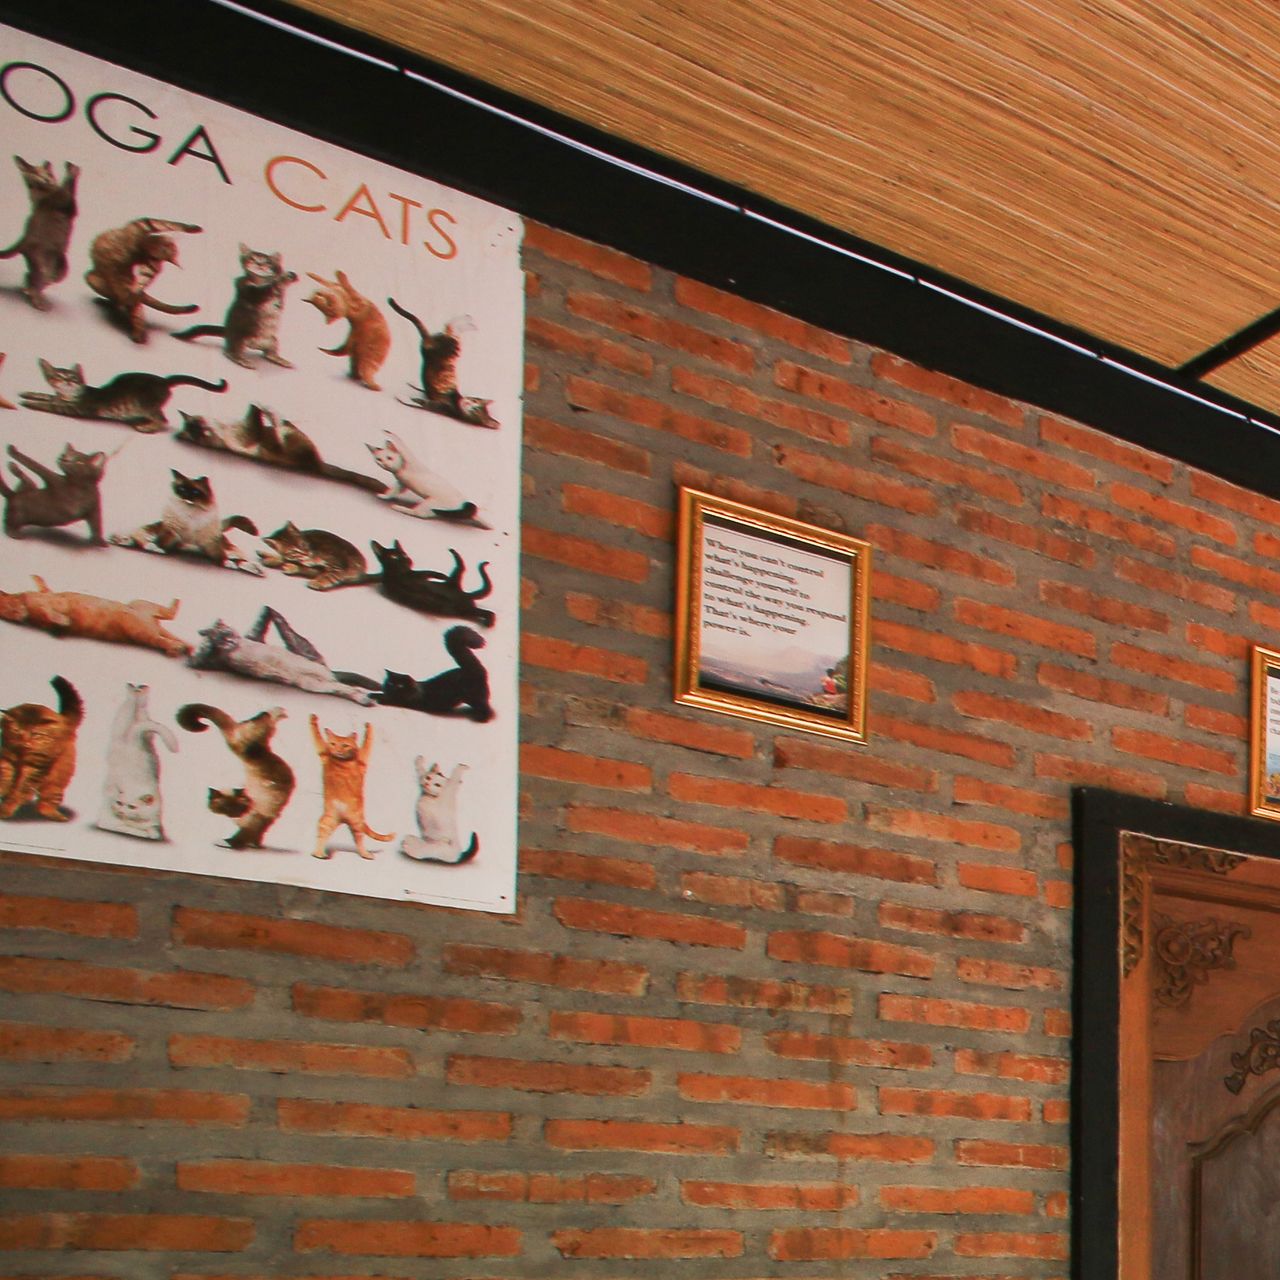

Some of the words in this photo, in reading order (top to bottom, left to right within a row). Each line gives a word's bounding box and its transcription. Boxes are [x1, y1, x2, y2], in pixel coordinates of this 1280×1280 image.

[264, 155, 458, 261] CATS
[705, 537, 737, 553] When
[740, 550, 758, 560] you
[787, 563, 825, 578] control
[704, 593, 715, 601] to
[705, 567, 754, 585] challenge
[756, 581, 799, 596] yourself
[799, 591, 811, 600] to
[704, 581, 743, 595] control
[745, 590, 761, 600] the
[764, 596, 784, 607] way
[786, 602, 804, 611] you
[806, 607, 847, 623] respond
[703, 621, 736, 633] power
[739, 615, 771, 629] where
[773, 624, 797, 635] your
